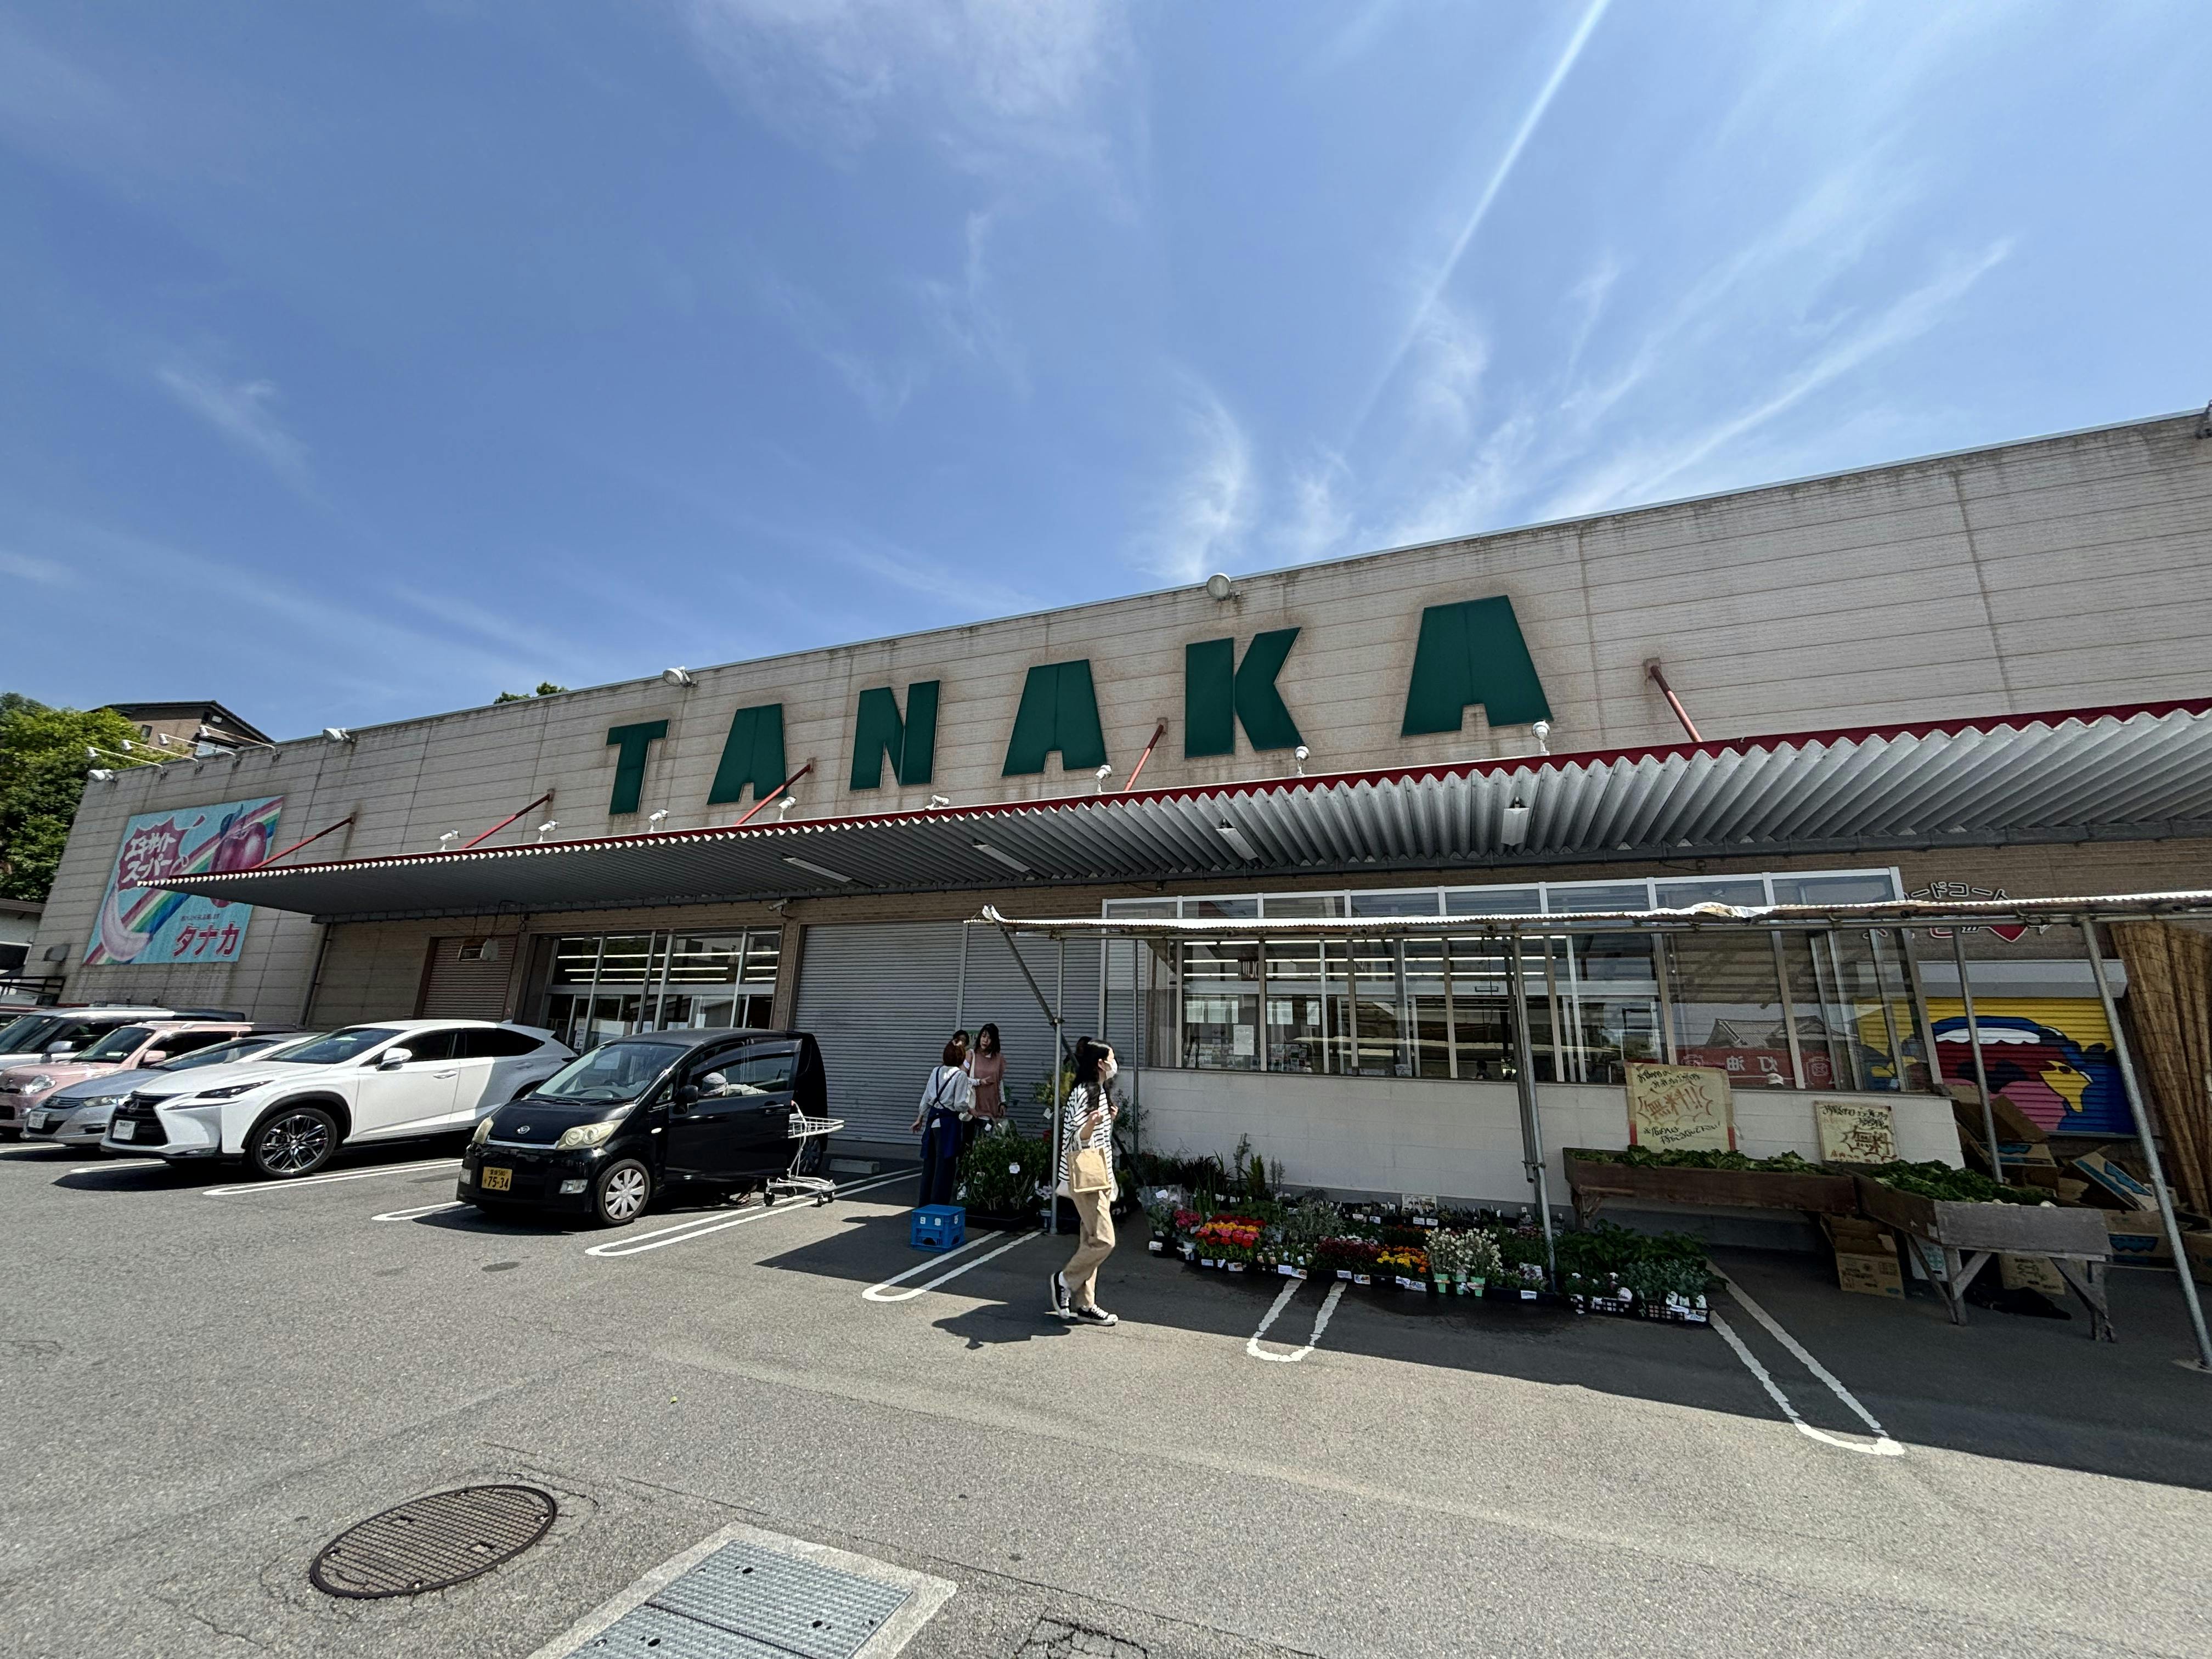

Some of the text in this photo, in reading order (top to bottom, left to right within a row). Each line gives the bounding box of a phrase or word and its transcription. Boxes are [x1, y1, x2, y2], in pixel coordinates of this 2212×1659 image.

[606, 595, 1554, 815] TANAKA
[121, 853, 173, 883] スーパー
[173, 922, 240, 957] タナカ
[488, 1176, 509, 1189] 75-34
